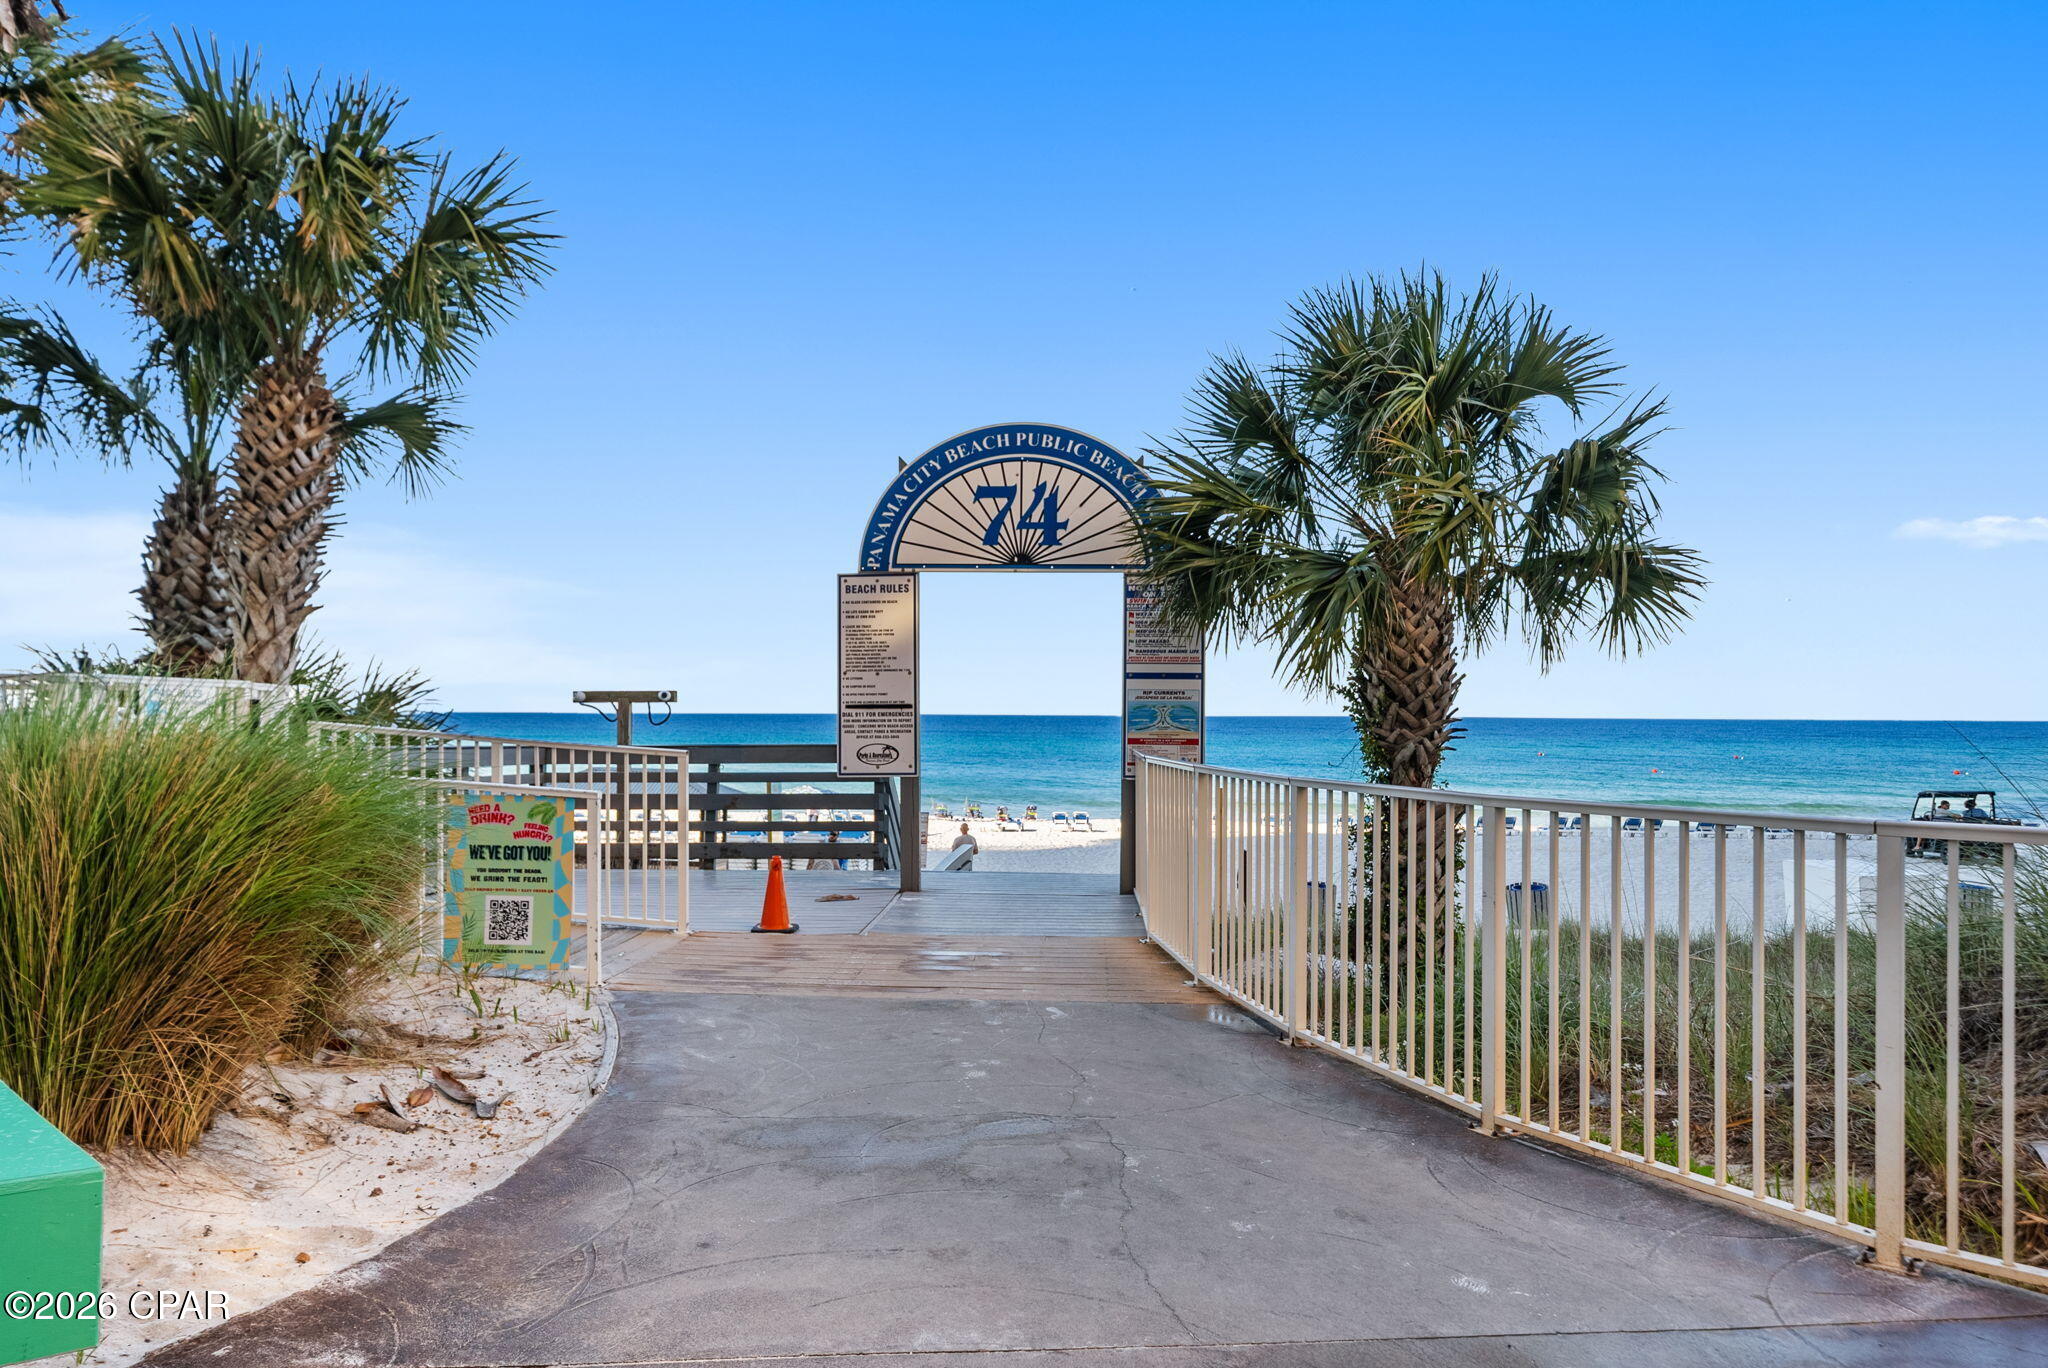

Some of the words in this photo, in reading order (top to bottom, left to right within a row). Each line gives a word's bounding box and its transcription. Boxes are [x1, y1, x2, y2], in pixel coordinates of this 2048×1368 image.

[945, 433, 1010, 464] BEACH
[1016, 432, 1089, 458] PUBLIC
[1089, 449, 1147, 499] BEACH
[973, 481, 1069, 546] 74
[845, 585, 876, 593] BEACH
[880, 584, 909, 593] RULES
[468, 804, 490, 815] NEED
[494, 803, 500, 812] A
[471, 813, 515, 825] DRINK?
[524, 823, 549, 832] FEELING
[513, 831, 553, 843] HUNGRY?
[470, 845, 501, 860] WE'VE
[503, 845, 526, 860] GOT
[526, 846, 551, 861] YOU!
